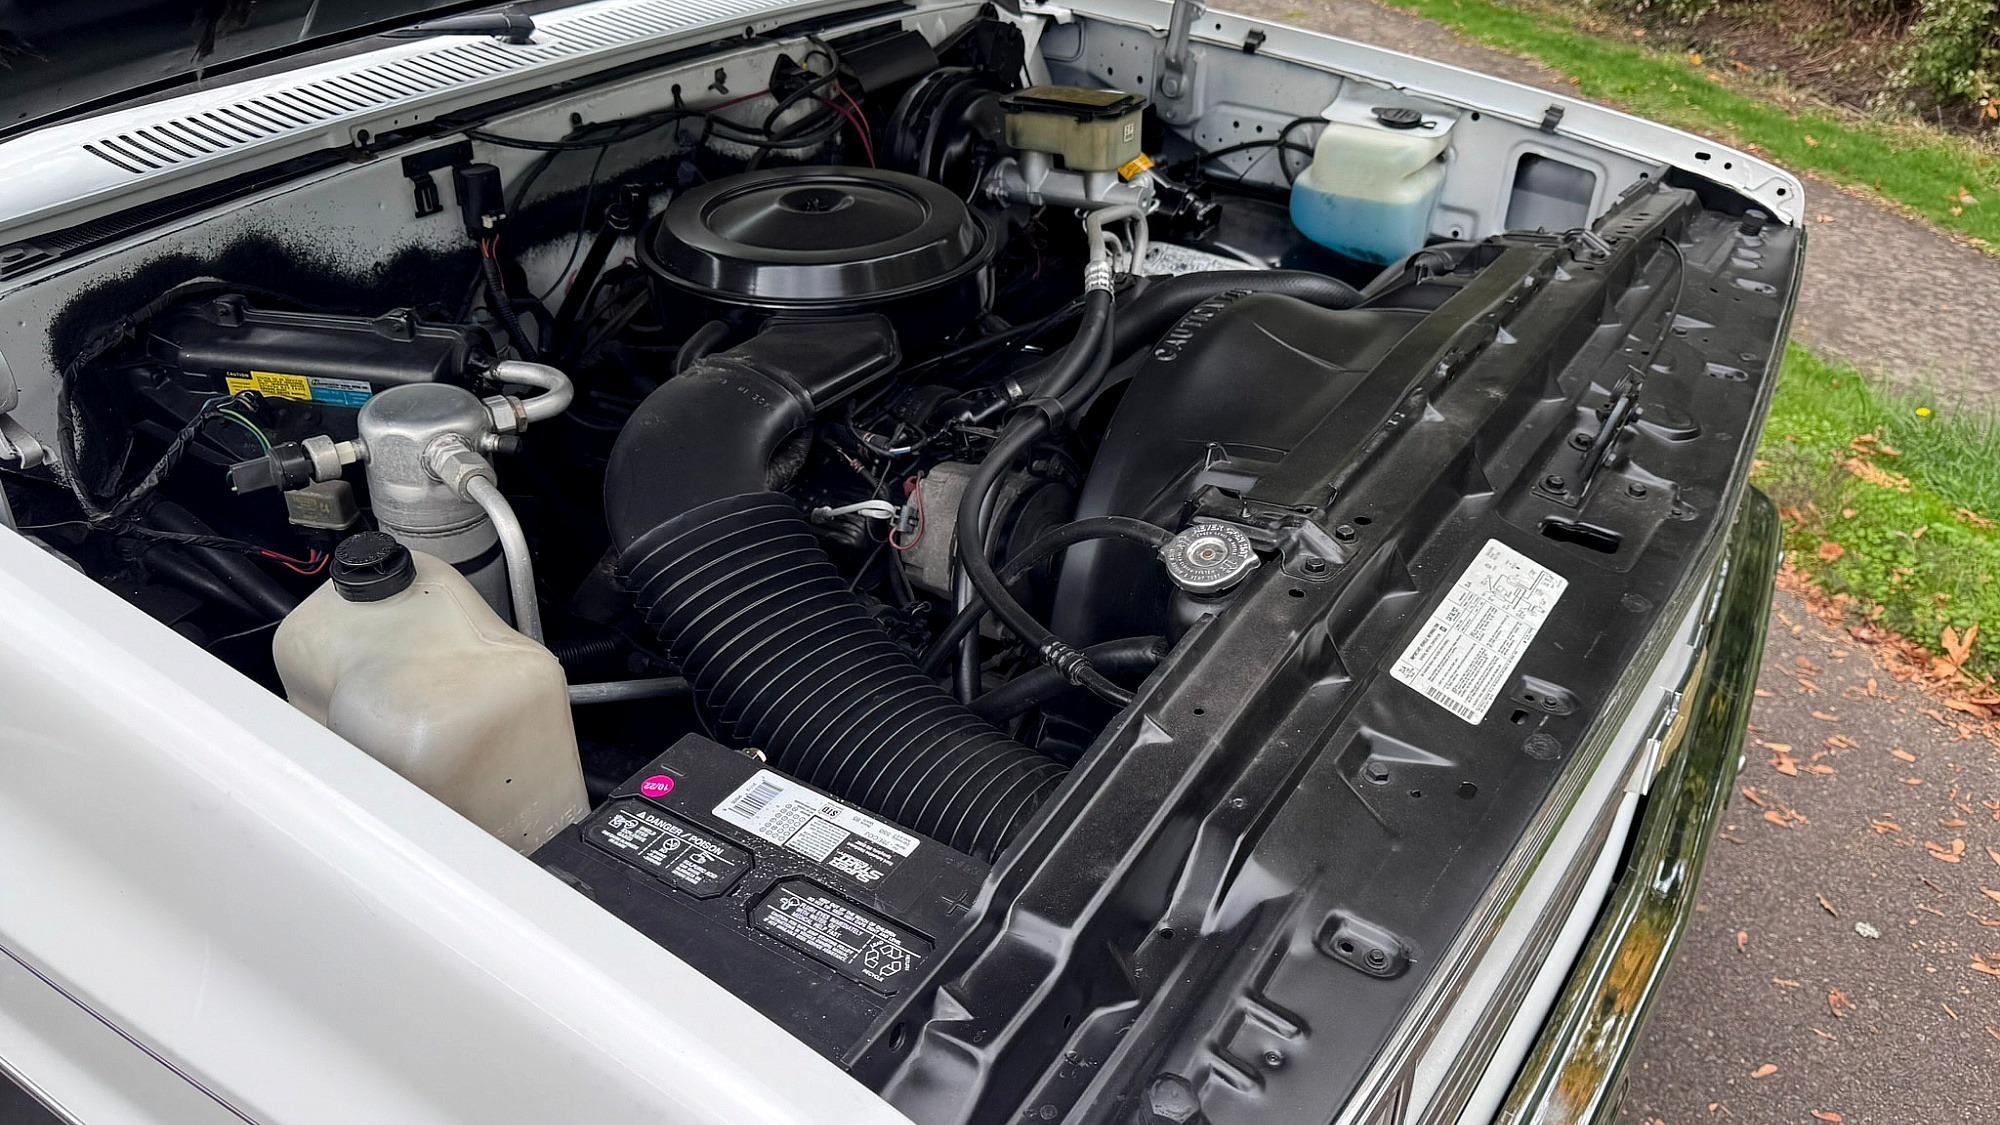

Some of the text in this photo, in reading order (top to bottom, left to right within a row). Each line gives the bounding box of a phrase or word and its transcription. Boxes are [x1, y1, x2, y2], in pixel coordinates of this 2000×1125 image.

[644, 782, 669, 791] 10/22
[644, 814, 684, 835] DANGER
[687, 835, 724, 855] POISON
[828, 860, 871, 883] SUPER
[833, 854, 884, 880] START
[790, 911, 841, 938] MEDICAL HELP FAST
[827, 922, 840, 931] GET
[829, 916, 864, 936] IMMEDIATELY
[862, 968, 885, 983] RECYCLE
